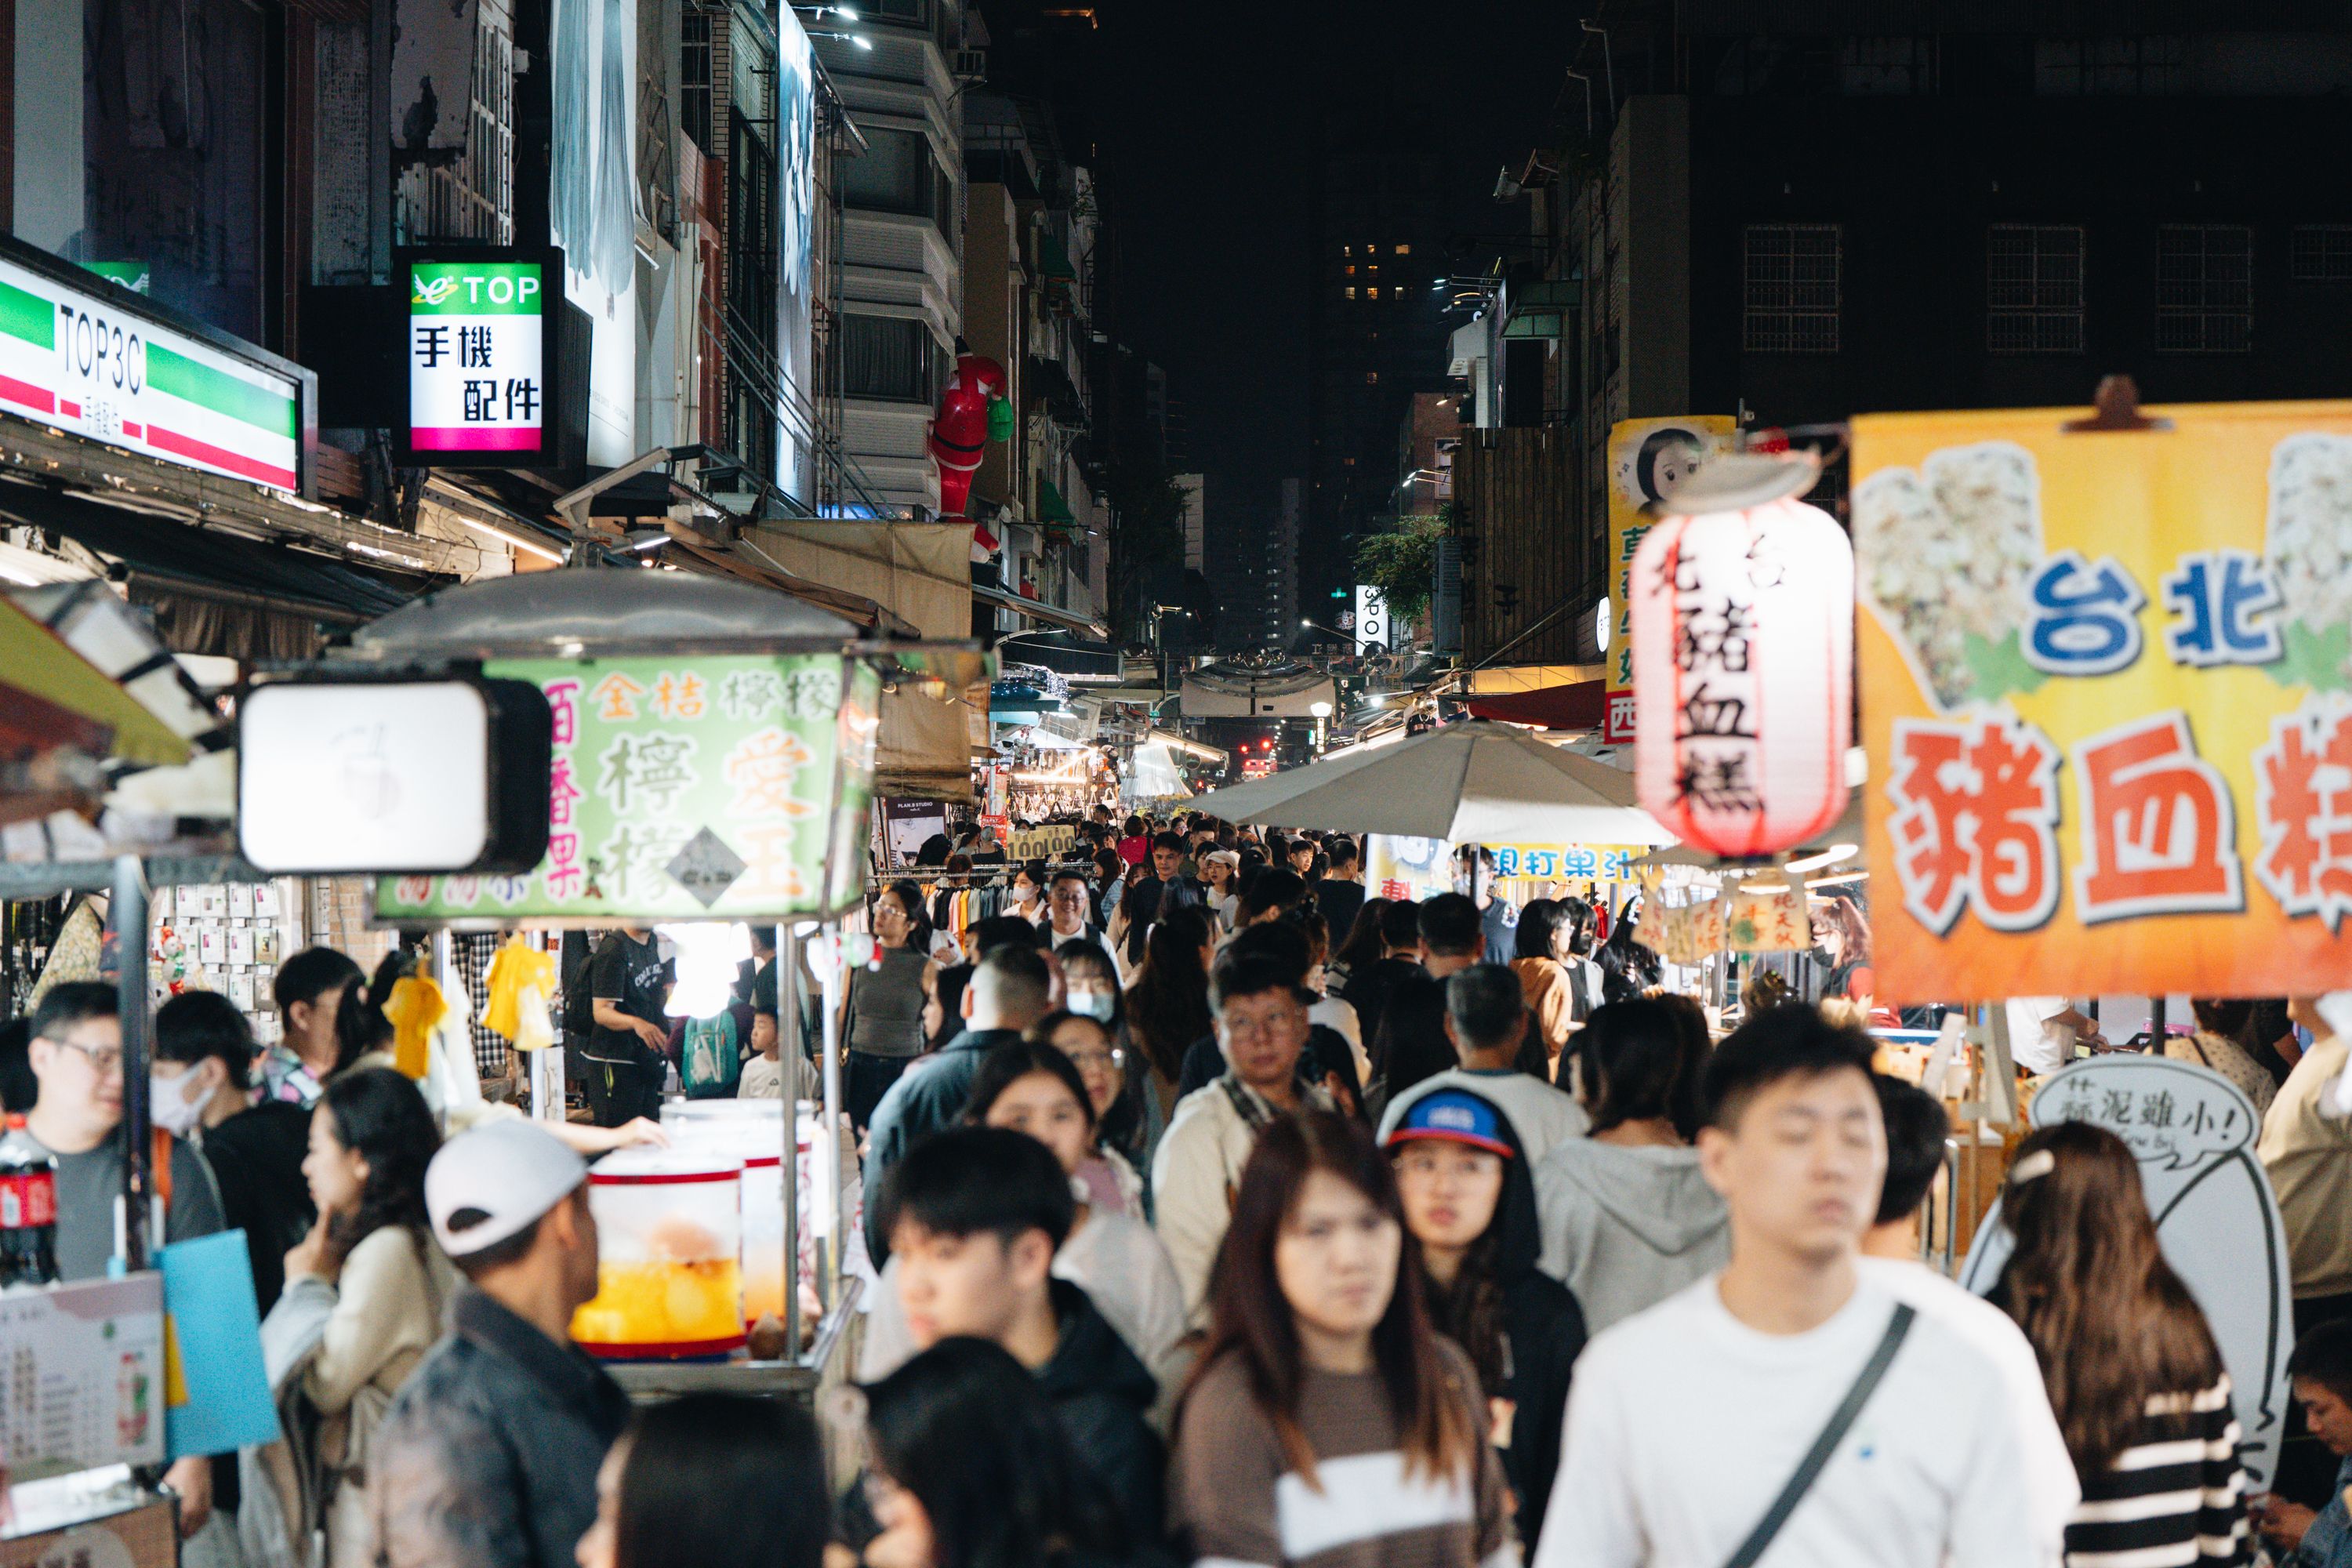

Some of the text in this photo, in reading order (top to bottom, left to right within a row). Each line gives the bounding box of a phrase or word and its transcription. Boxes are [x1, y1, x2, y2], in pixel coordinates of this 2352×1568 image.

[463, 276, 539, 304] TOP
[60, 303, 140, 395] TOP3C
[415, 325, 492, 368] 手機
[463, 378, 540, 421] 配件
[2023, 551, 2281, 666] 台北
[725, 729, 817, 902] 愛玉
[1007, 841, 1045, 859] 100
[1044, 835, 1076, 855] 100
[1492, 846, 1631, 880] 現打果汁
